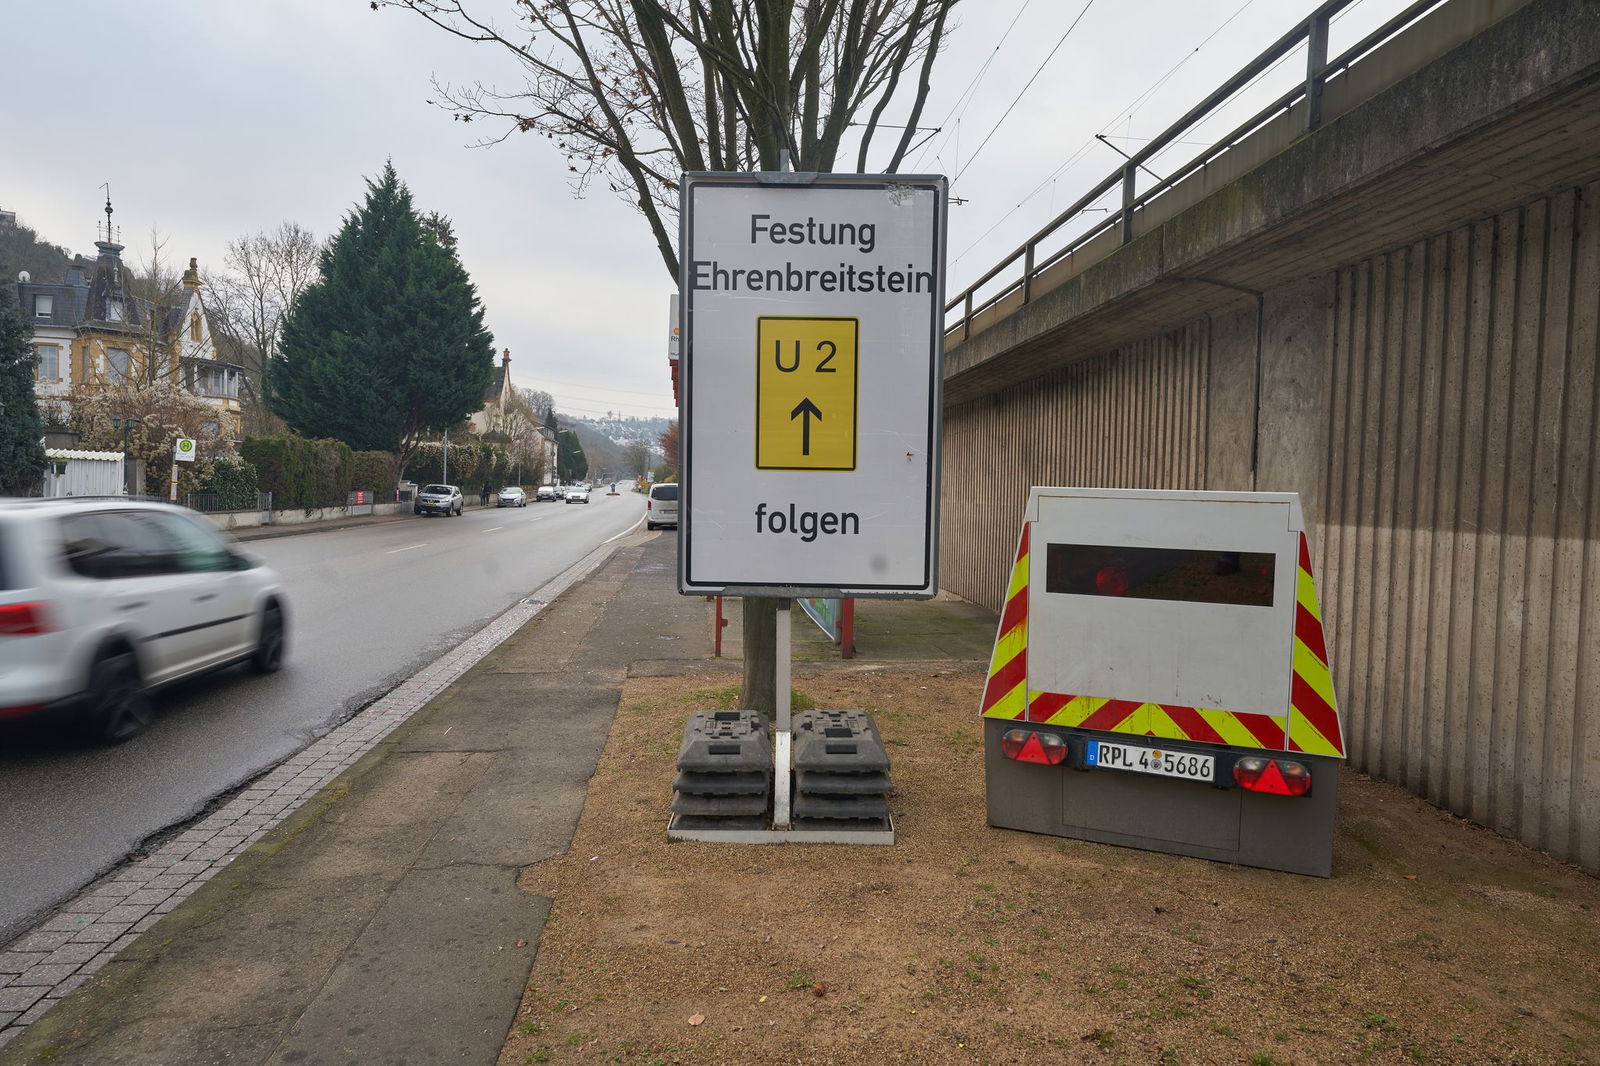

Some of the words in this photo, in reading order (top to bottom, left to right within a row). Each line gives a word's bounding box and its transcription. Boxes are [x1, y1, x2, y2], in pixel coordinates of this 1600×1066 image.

[750, 214, 876, 253] Festung
[693, 261, 933, 294] Ehrenbreitstein
[774, 339, 801, 373] U
[815, 340, 837, 373] 2
[755, 503, 860, 543] folgen
[1099, 744, 1133, 767] RPL
[1139, 750, 1149, 769] 4
[1164, 753, 1211, 778] 5686
